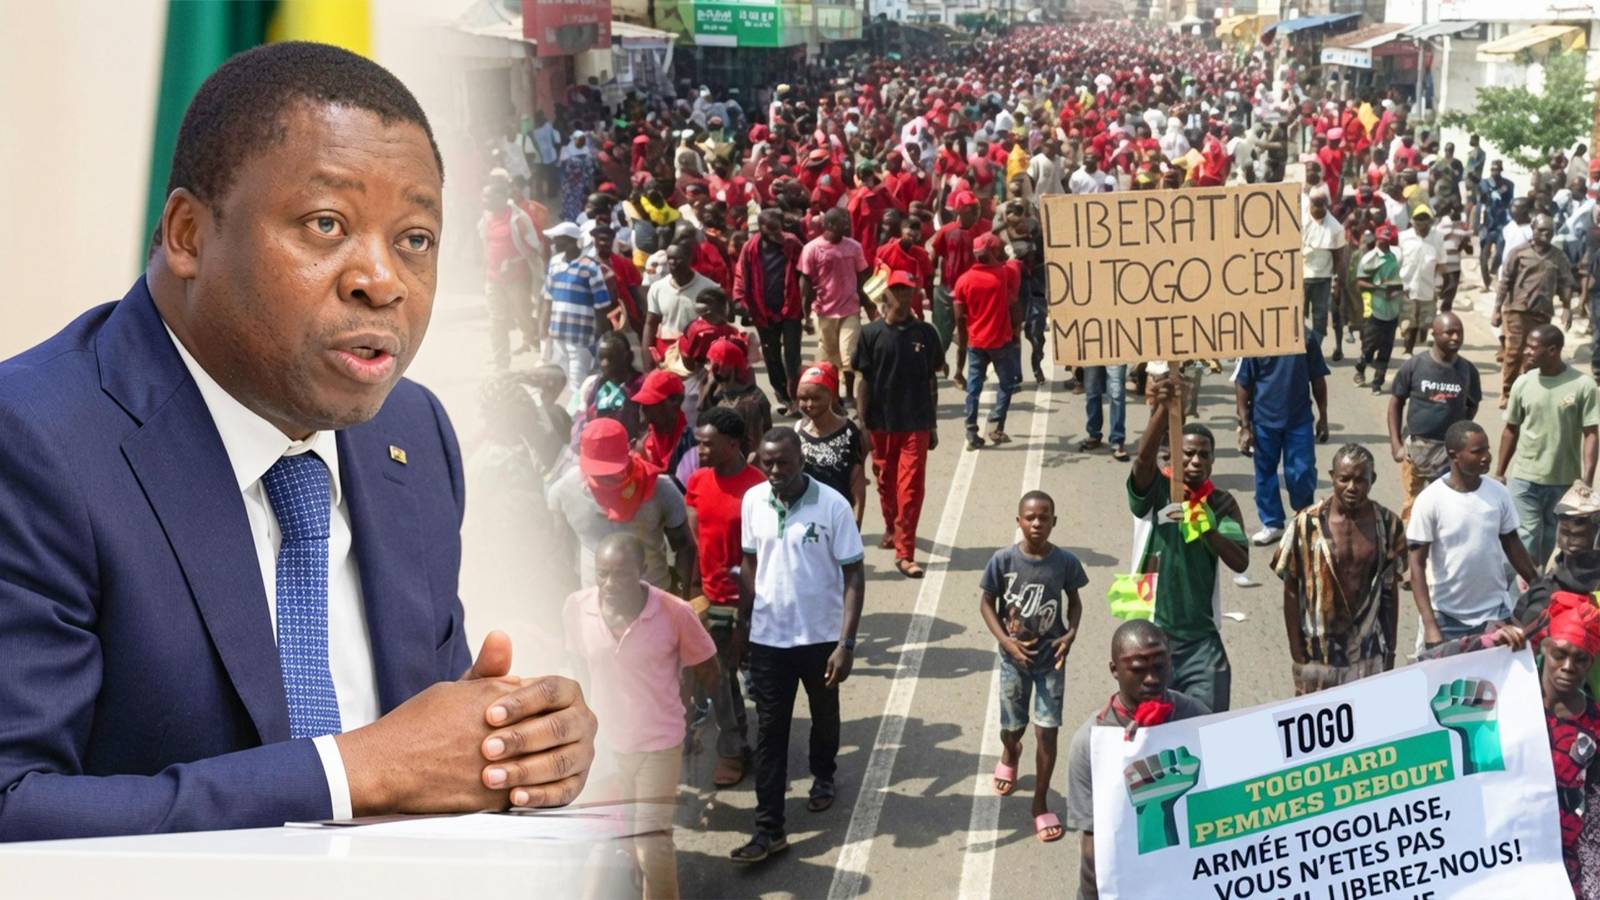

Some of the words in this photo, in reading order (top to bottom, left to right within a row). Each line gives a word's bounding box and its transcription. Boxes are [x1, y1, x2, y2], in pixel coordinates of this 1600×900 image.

[1045, 190, 1300, 248] LIBERATION
[1045, 260, 1092, 306] DU
[1100, 257, 1212, 305] TOGO
[1222, 248, 1301, 296] C'EST
[1052, 306, 1300, 361] MAINTENANT!
[1278, 703, 1354, 758] TOGO
[1194, 791, 1325, 843] PEMMES
[1333, 759, 1448, 807] DEBOUT
[1245, 746, 1398, 802] TOGOLARD
[1192, 834, 1290, 881] ARMÉE
[1295, 796, 1451, 852] TOGOLAISE,
[1214, 866, 1292, 900] VOUS
[1397, 827, 1446, 858] PAS
